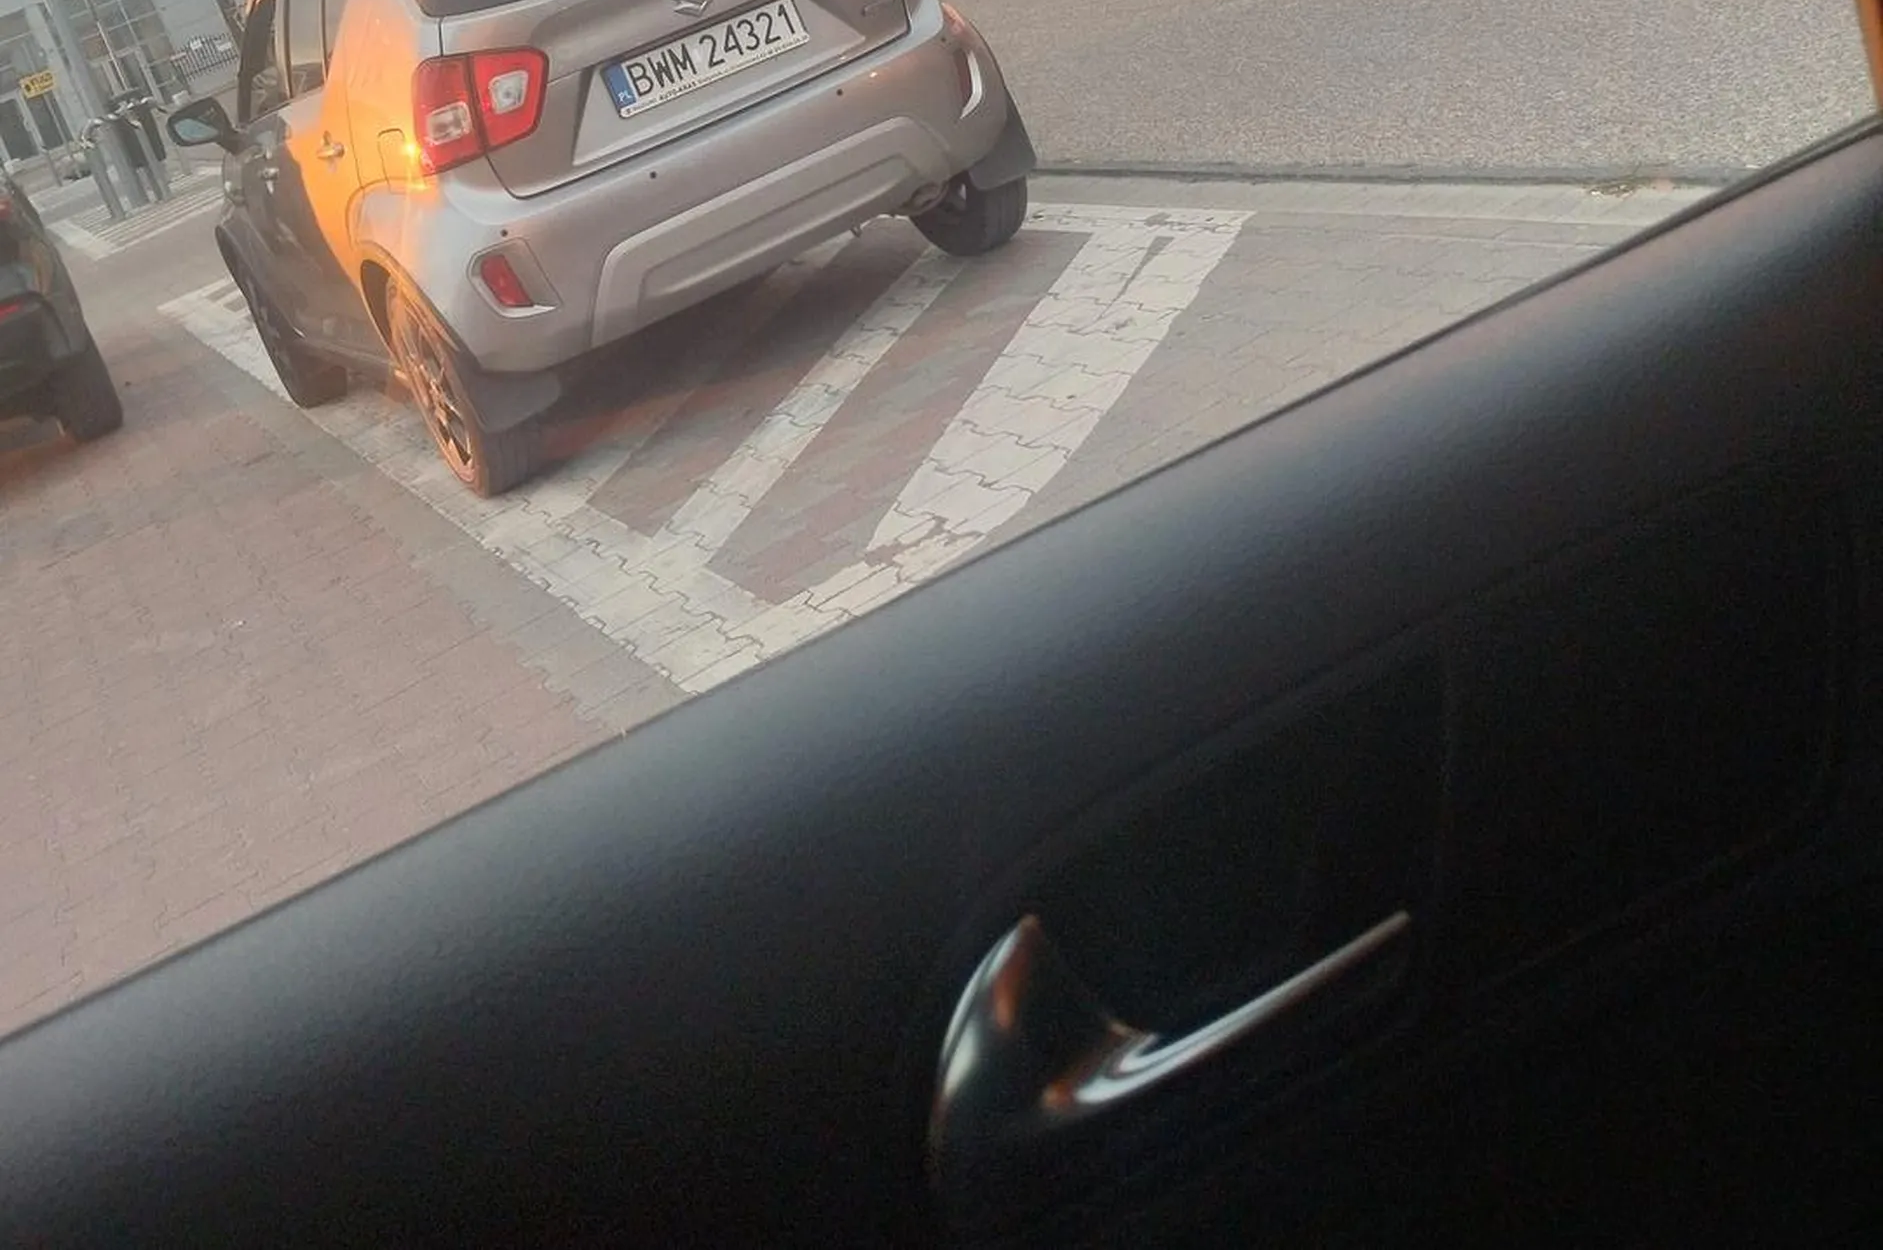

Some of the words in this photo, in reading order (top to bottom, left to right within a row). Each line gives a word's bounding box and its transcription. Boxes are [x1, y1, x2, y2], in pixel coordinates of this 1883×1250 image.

[627, 42, 698, 97] BWM
[698, 3, 796, 70] 24321
[616, 89, 634, 105] PL
